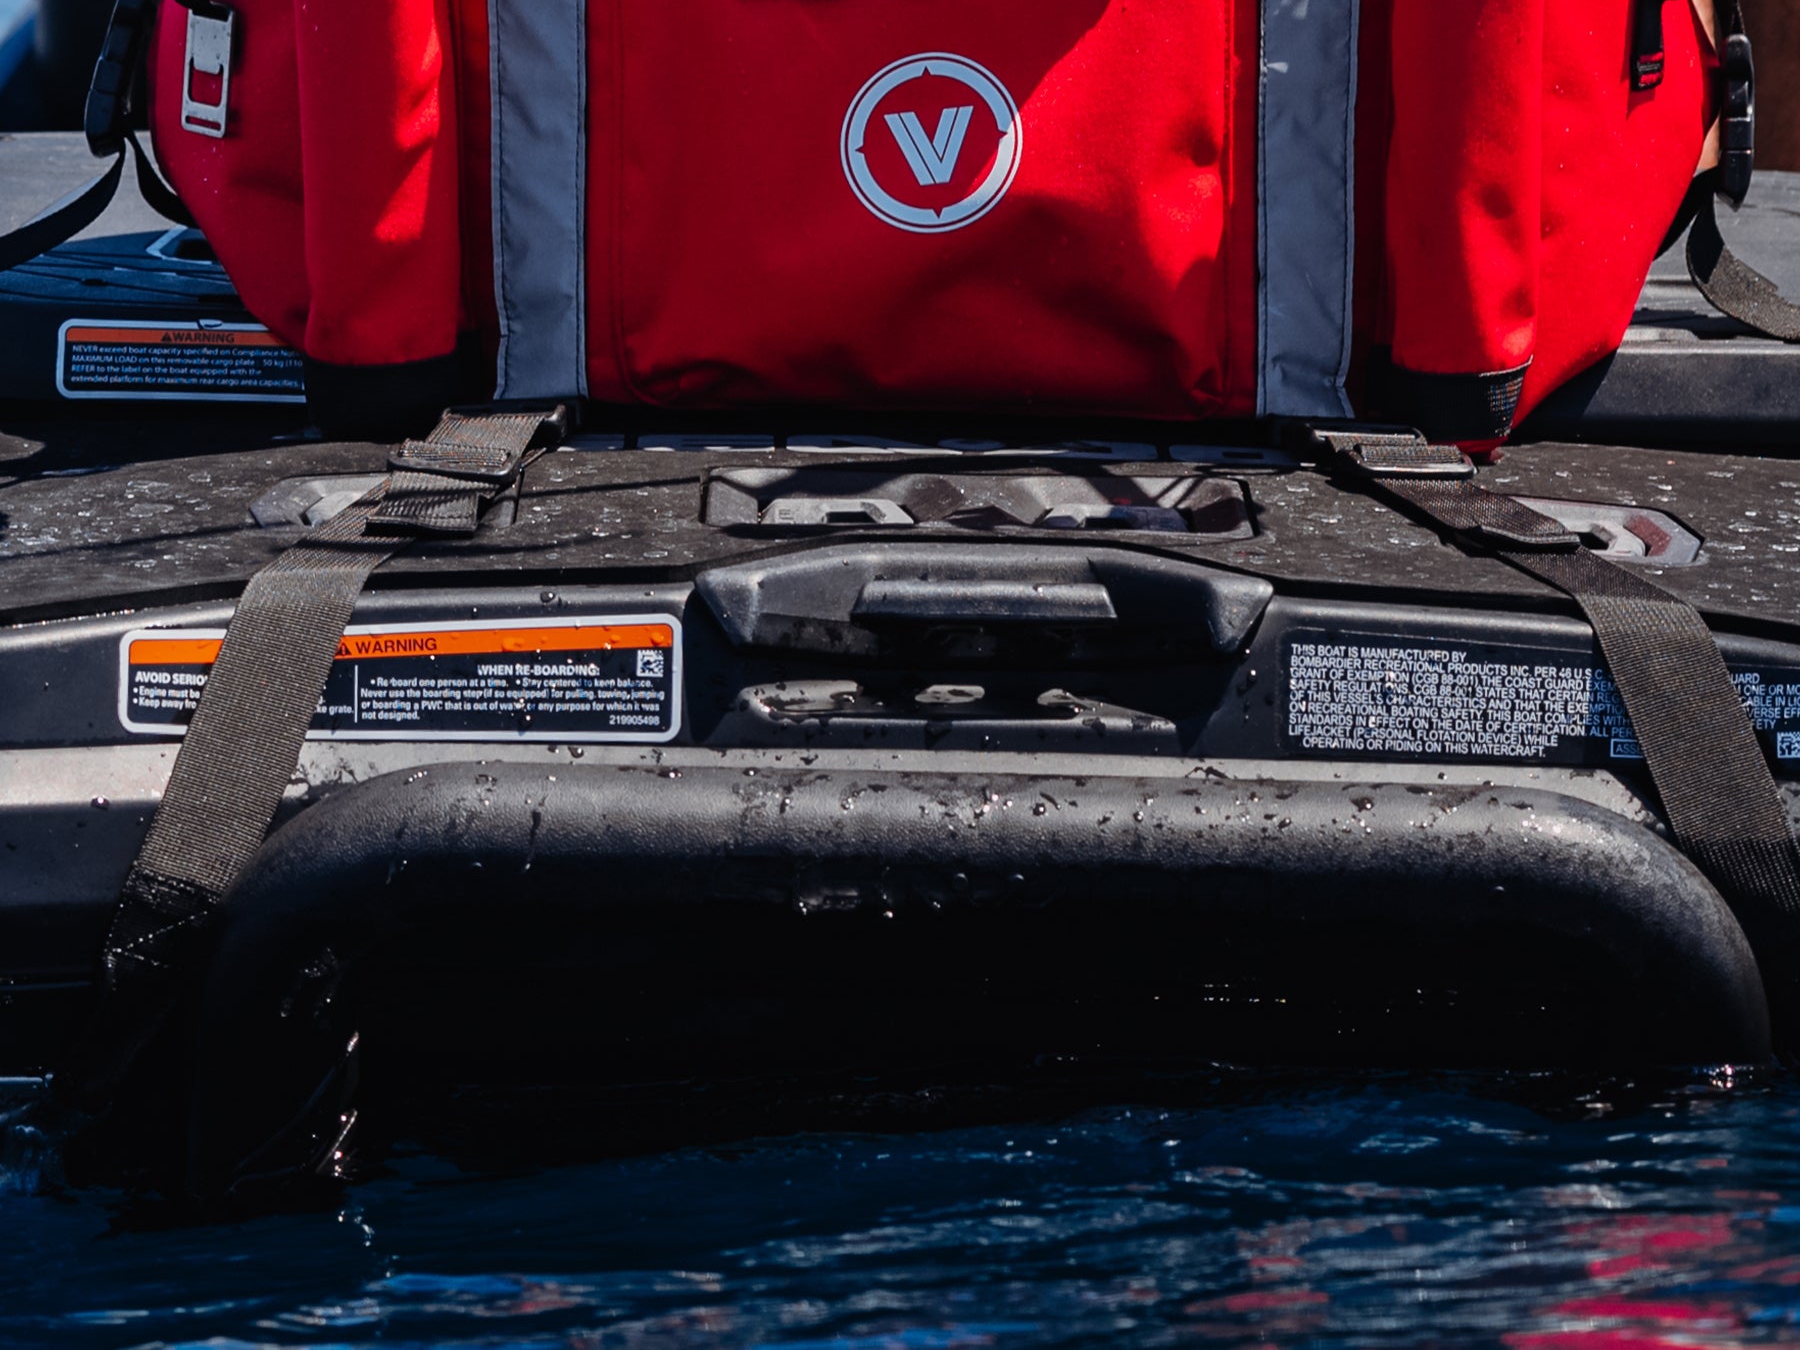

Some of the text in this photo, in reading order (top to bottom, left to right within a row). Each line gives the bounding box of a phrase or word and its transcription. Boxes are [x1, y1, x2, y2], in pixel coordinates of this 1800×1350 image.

[173, 333, 235, 343] WARNING
[129, 346, 147, 354] boat
[148, 348, 181, 356] capacity
[72, 355, 113, 363] MAXIMUM
[211, 359, 234, 367] cargo
[122, 365, 141, 373] label
[216, 378, 239, 386] cargo
[355, 638, 437, 654] WARNING
[1291, 644, 1466, 663] THIS BOAT IS MANUFACTURED BY
[477, 664, 600, 676] WHEN RE-BOARDING:
[1291, 655, 1361, 669] BOMBARDIER
[1364, 659, 1444, 672] RECREATIONAL
[1448, 663, 1508, 676] PRODUCTS
[1510, 666, 1532, 677] INC.
[1534, 666, 1556, 678] PER
[135, 671, 171, 684] AVOID
[419, 679, 436, 687] one
[437, 679, 467, 688] person
[469, 678, 478, 687] at
[480, 679, 486, 687] a
[487, 677, 508, 687] time.
[1291, 668, 1784, 695] GRANT OF EXEMPTION (CGB THE COAST GUARD ONE OR
[139, 686, 200, 699] Engine must be
[361, 689, 387, 698] Never
[389, 690, 405, 698] use
[407, 689, 421, 698] the
[422, 689, 461, 700] boarding
[494, 690, 505, 698] so
[1290, 679, 1786, 706] SAFETY CGB 88-001 STATES THAT CERTAIN IN
[161, 700, 183, 710] away
[373, 699, 411, 711] boarding
[421, 700, 443, 710] PWC
[445, 700, 461, 710] that
[464, 700, 471, 710] is
[473, 700, 487, 710] out
[489, 700, 498, 710] of
[538, 703, 554, 712] any
[556, 703, 590, 712] purpose
[592, 701, 605, 711] for
[1290, 691, 1305, 699] OF
[1308, 691, 1331, 702] THIS
[1334, 692, 1384, 704] VESSEL'S
[1488, 699, 1511, 710] AND
[1514, 700, 1540, 711] THAT
[1544, 701, 1564, 712] THE
[362, 711, 420, 721] not designed.
[1289, 701, 1306, 712] ON
[1308, 703, 1388, 716] RECREATIONAL
[1391, 706, 1438, 718] BOATING
[1487, 710, 1511, 721] THIS
[1514, 711, 1541, 722] BOAT
[1544, 712, 1600, 725] COMPLIES
[609, 715, 660, 725] 219905498
[1289, 713, 1353, 725] STANDARDS
[1356, 715, 1366, 726] IN
[1368, 716, 1410, 728] EFFECT
[1413, 718, 1428, 729] ON
[1431, 720, 1453, 732] THE
[1455, 719, 1483, 731] DATE
[1486, 721, 1501, 732] OF
[1590, 726, 1608, 737] ALL
[1288, 725, 1559, 747] LIFEJACKET (PERSONAL FLOTATION DEVICE) WHILE
[1303, 737, 1546, 757] OPERATING OR RIDING ON THIS WATERCRAFT.
